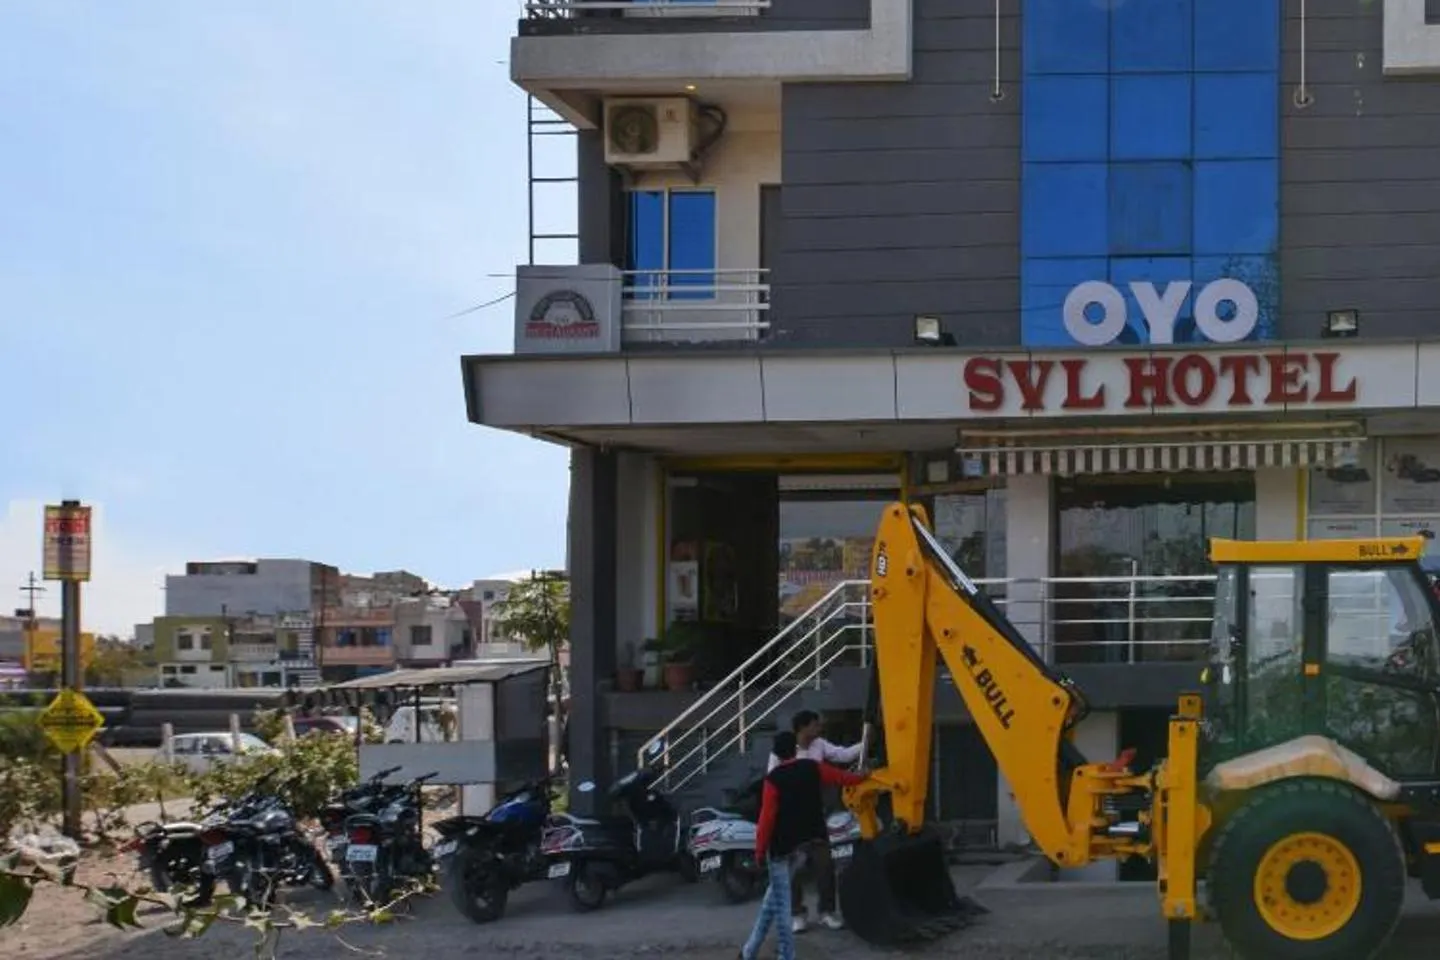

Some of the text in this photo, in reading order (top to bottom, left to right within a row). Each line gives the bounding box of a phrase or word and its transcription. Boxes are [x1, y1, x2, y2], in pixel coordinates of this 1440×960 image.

[1063, 278, 1259, 346] OYO
[963, 352, 1358, 411] SVL HOTEL
[1359, 544, 1390, 557] BULL
[976, 668, 1015, 730] BULL
